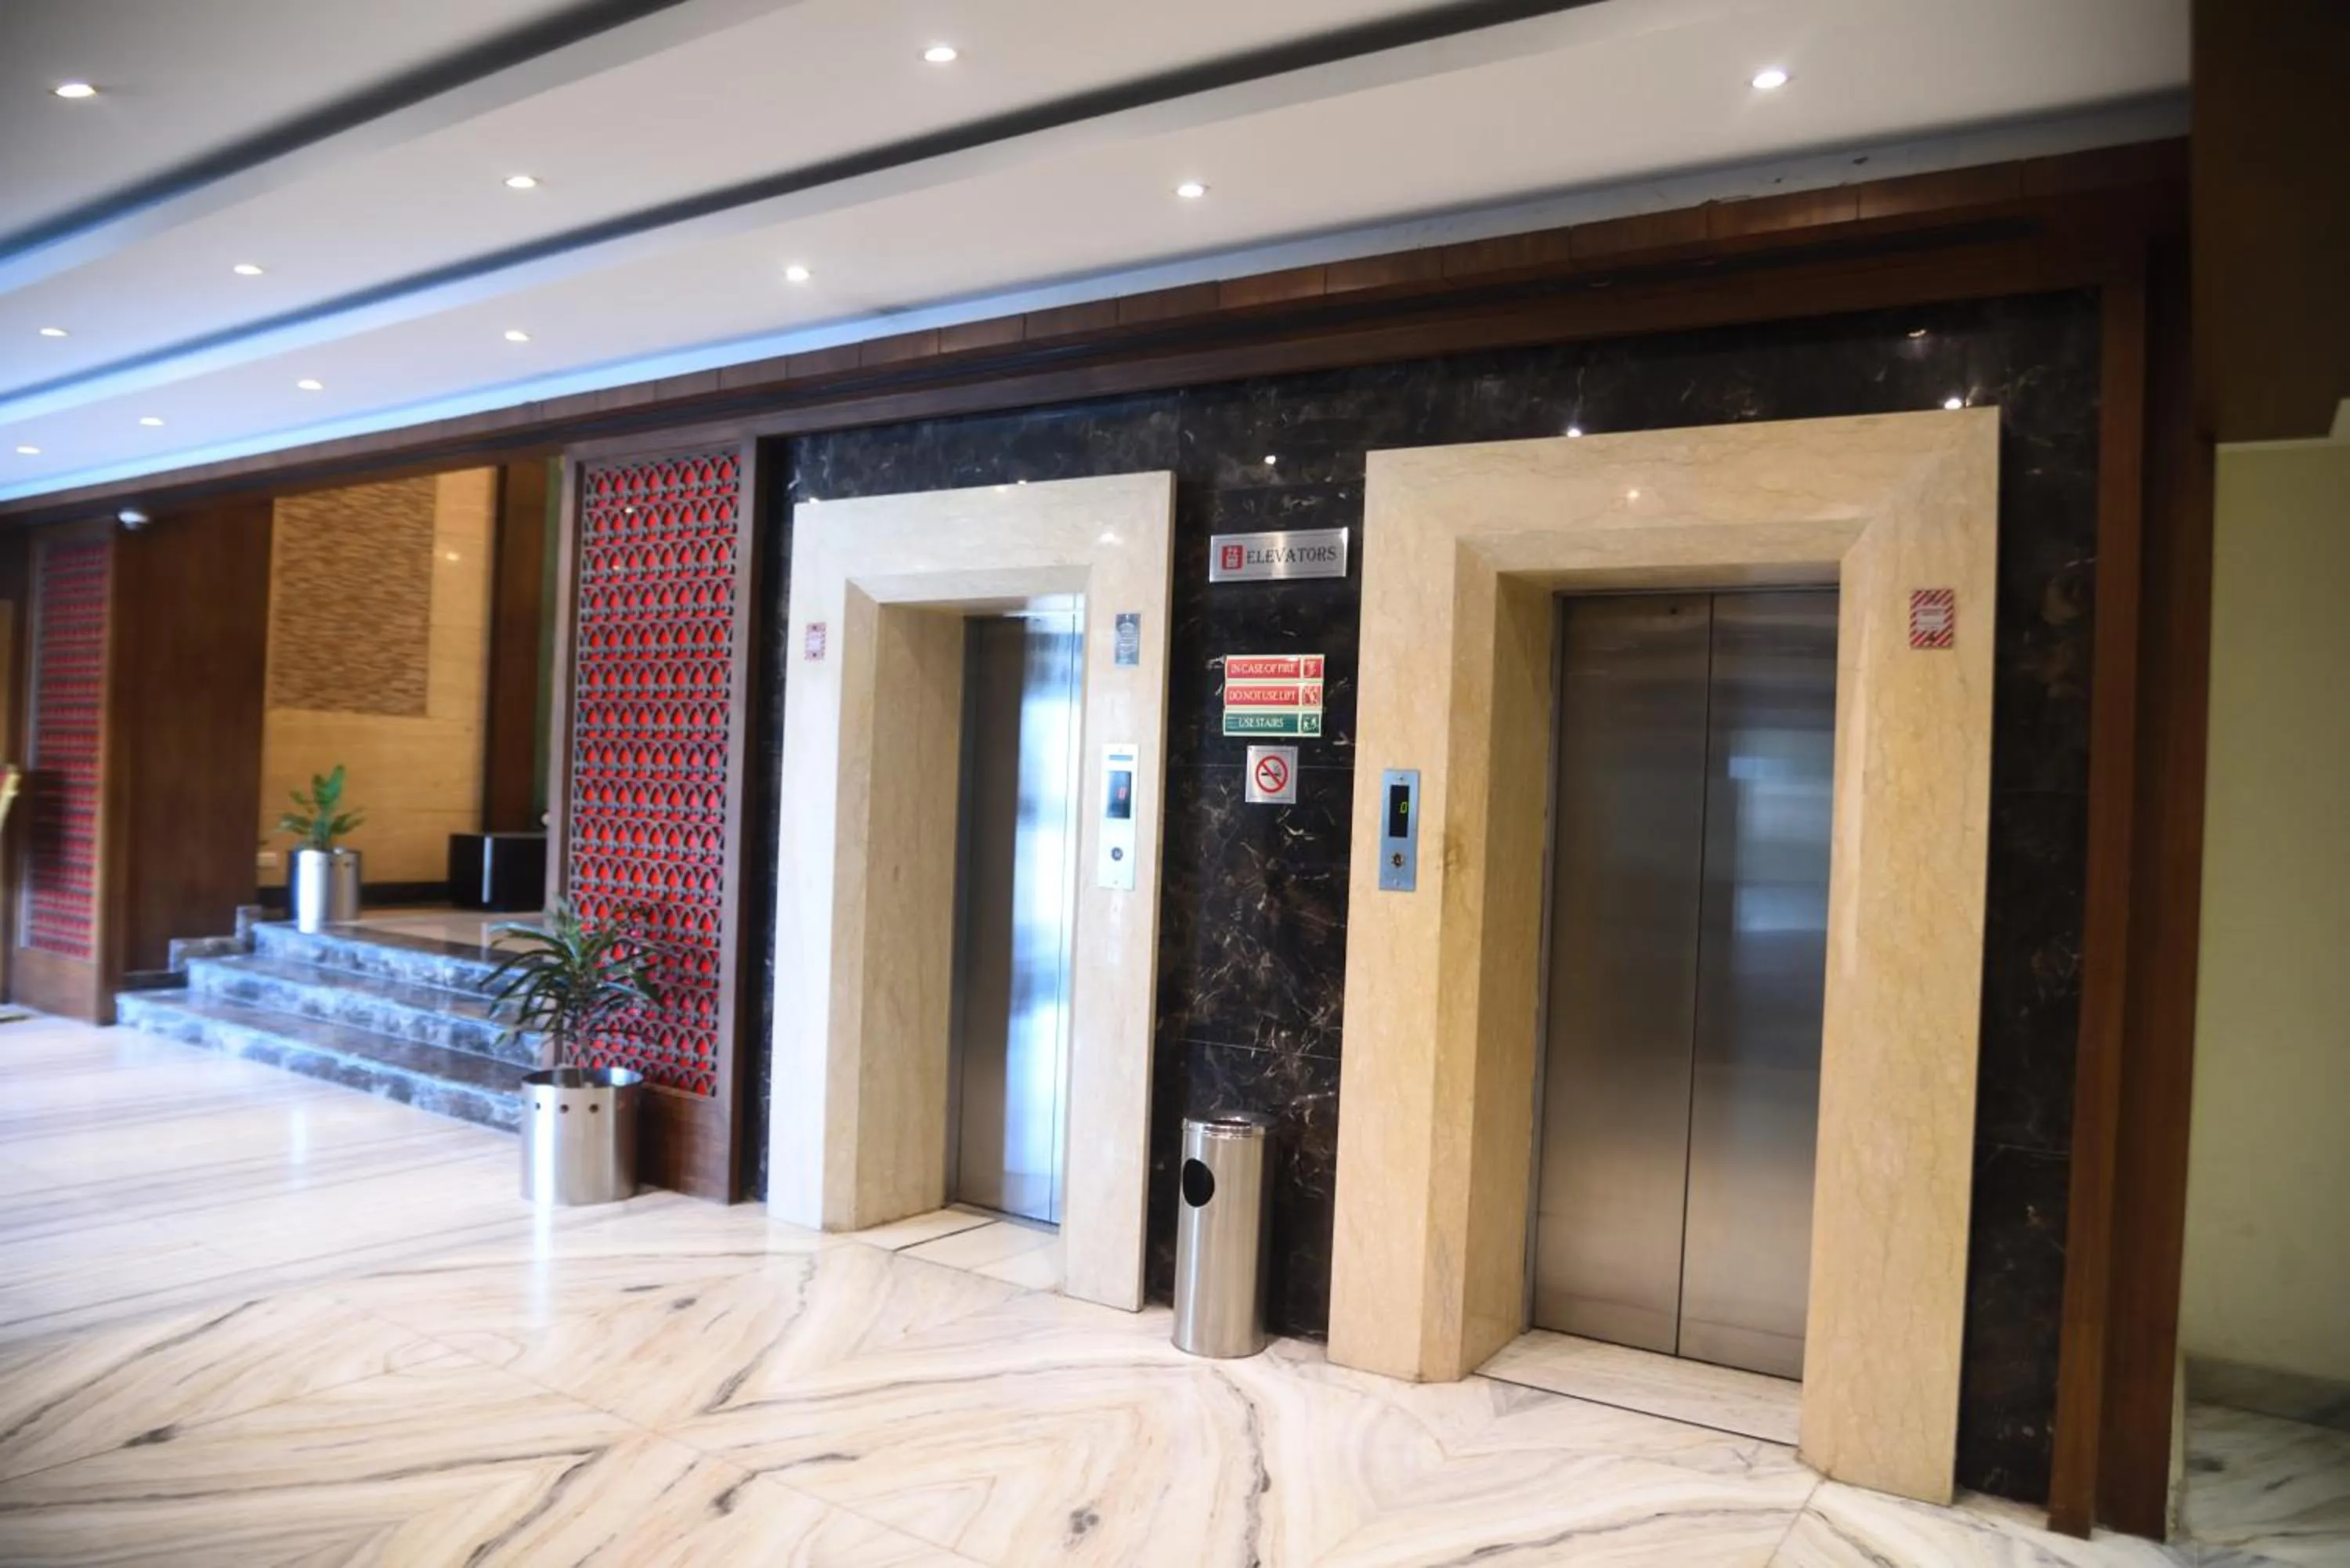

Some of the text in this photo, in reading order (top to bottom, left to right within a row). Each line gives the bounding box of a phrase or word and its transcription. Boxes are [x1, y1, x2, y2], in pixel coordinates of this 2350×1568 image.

[1247, 546, 1338, 564] ELEVATORS
[1231, 663, 1296, 674] IN CASE OF FIRE
[1229, 690, 1296, 701] DO NOT USE LIFT
[1238, 716, 1284, 728] USE STAIRS
